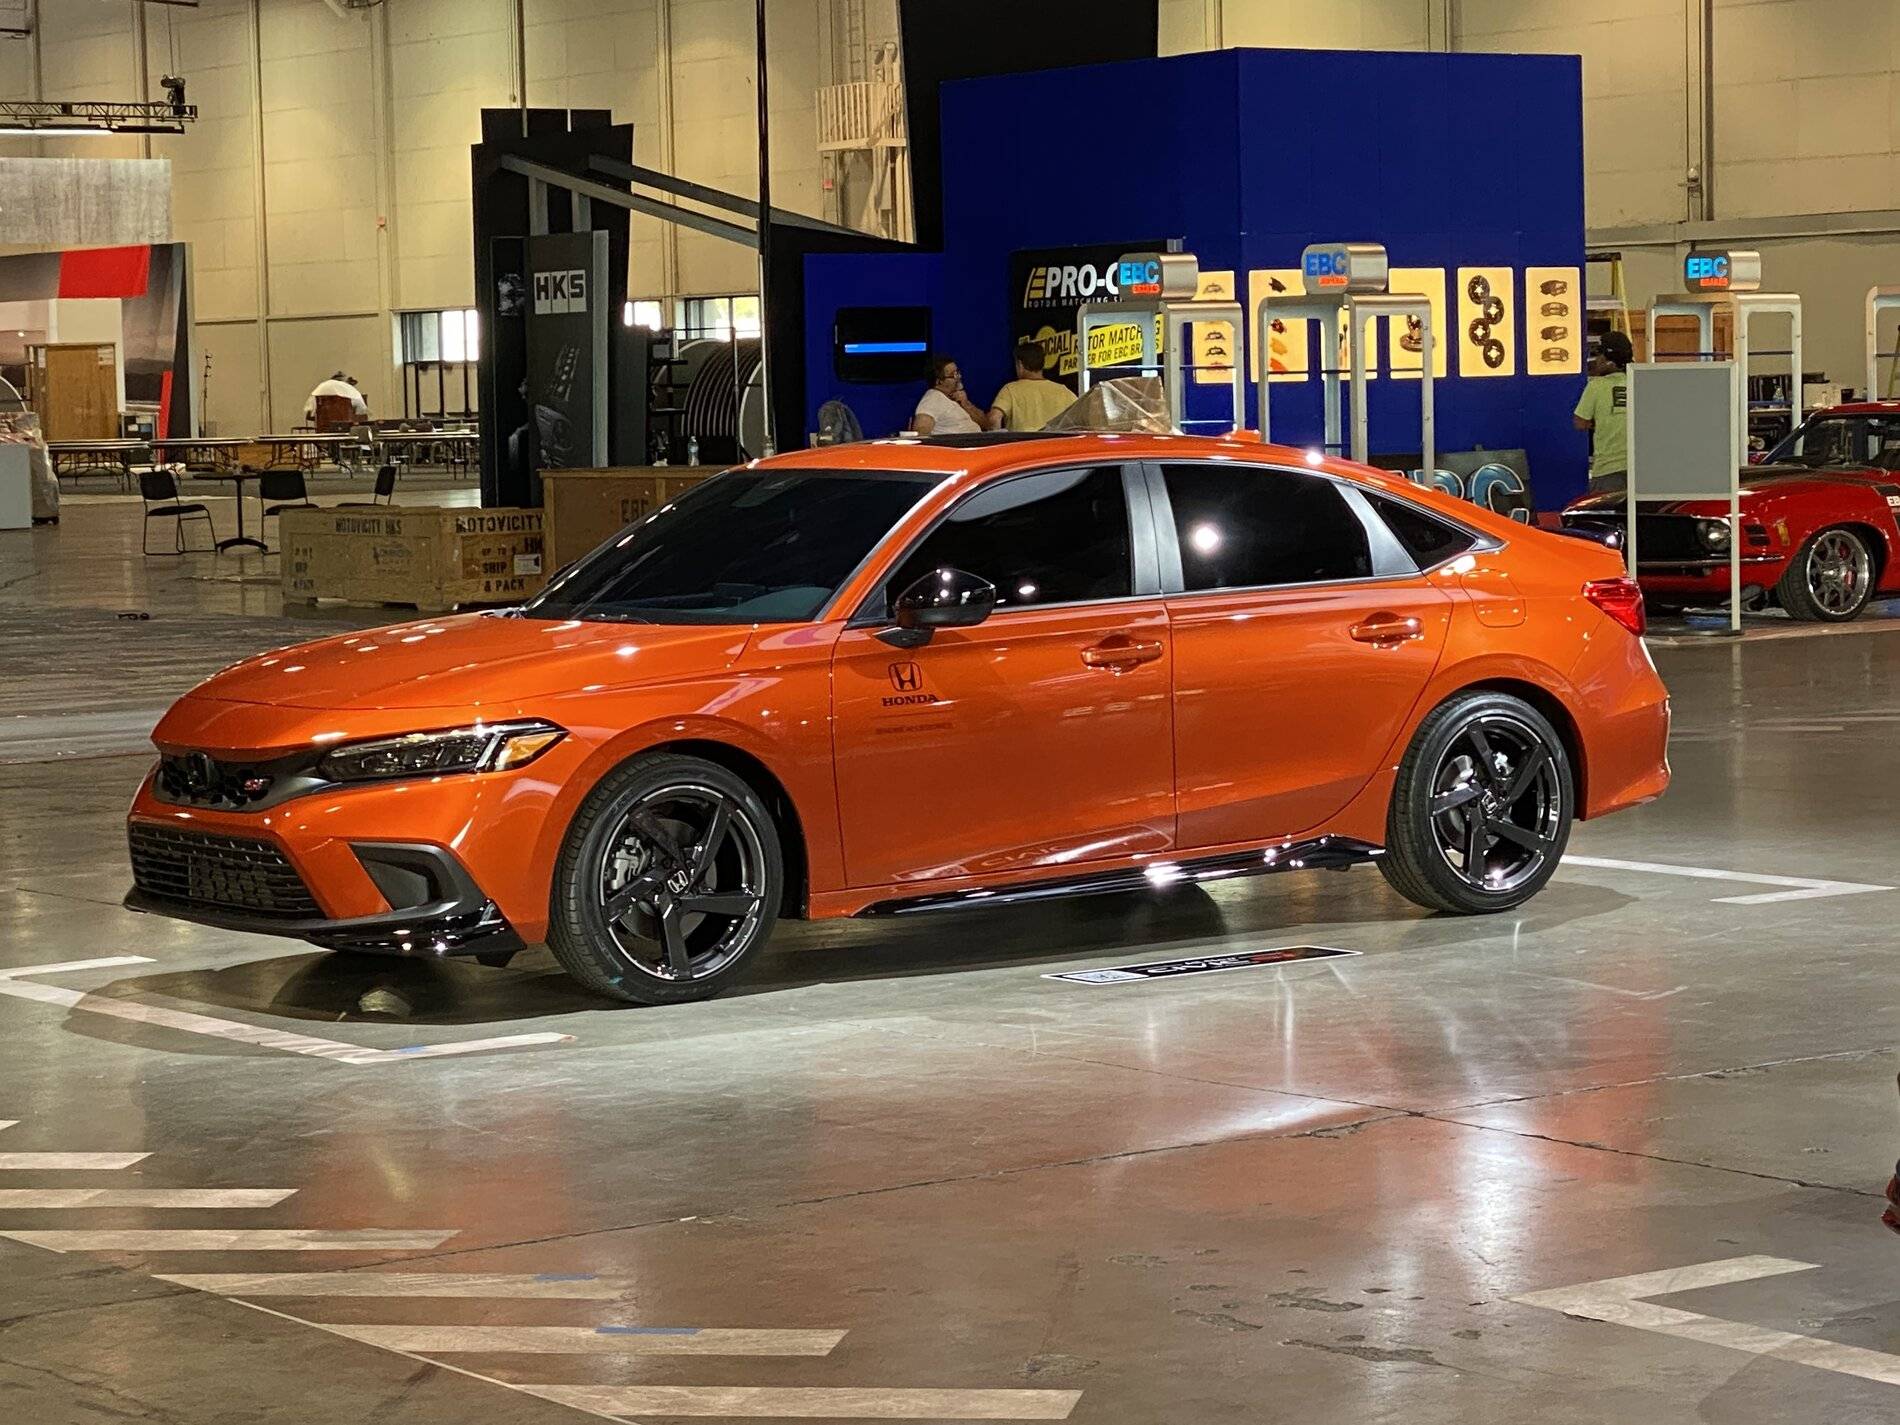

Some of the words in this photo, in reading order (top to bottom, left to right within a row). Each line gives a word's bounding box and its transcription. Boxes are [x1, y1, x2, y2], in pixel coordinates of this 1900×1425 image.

[1119, 261, 1160, 285] EBC
[1305, 252, 1345, 276] EBC
[1687, 256, 1728, 278] EBC
[536, 274, 584, 300] HKS
[1045, 262, 1119, 298] PRO-C
[1098, 349, 1113, 362] FOR
[1114, 345, 1129, 359] EBC
[1886, 495, 1900, 507] EB
[495, 578, 525, 592] PACK
[882, 694, 938, 707] HONDA
